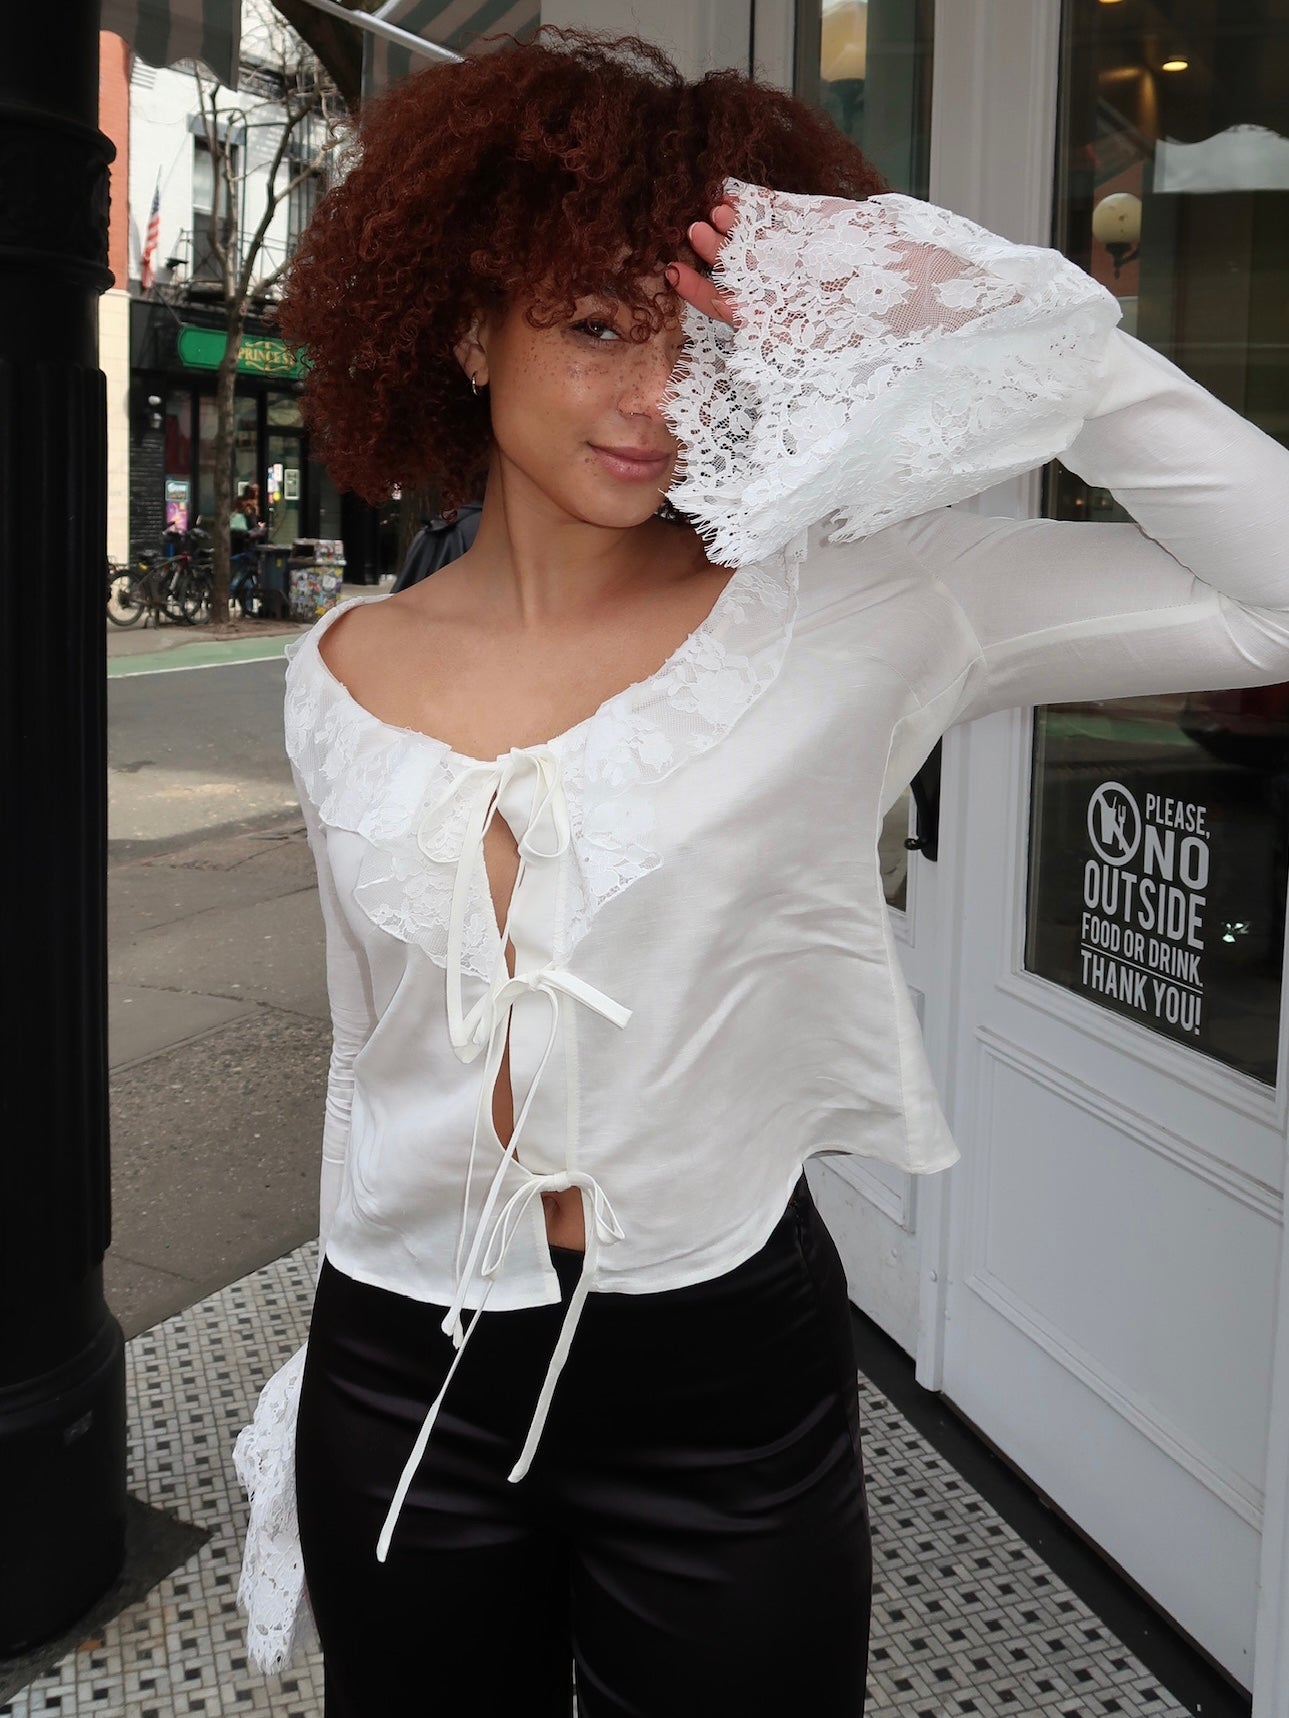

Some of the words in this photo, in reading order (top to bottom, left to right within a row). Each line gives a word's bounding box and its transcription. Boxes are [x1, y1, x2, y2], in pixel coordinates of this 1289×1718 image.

[1145, 793, 1210, 840] PLEASE,
[1143, 824, 1210, 890] NO
[1084, 859, 1207, 950] OUTSIDE
[1082, 911, 1121, 952] FOOD
[1123, 929, 1145, 963] OR
[1148, 938, 1204, 988] DRINK.
[1080, 949, 1148, 1012] THANK
[1152, 979, 1202, 1036] YOU!
